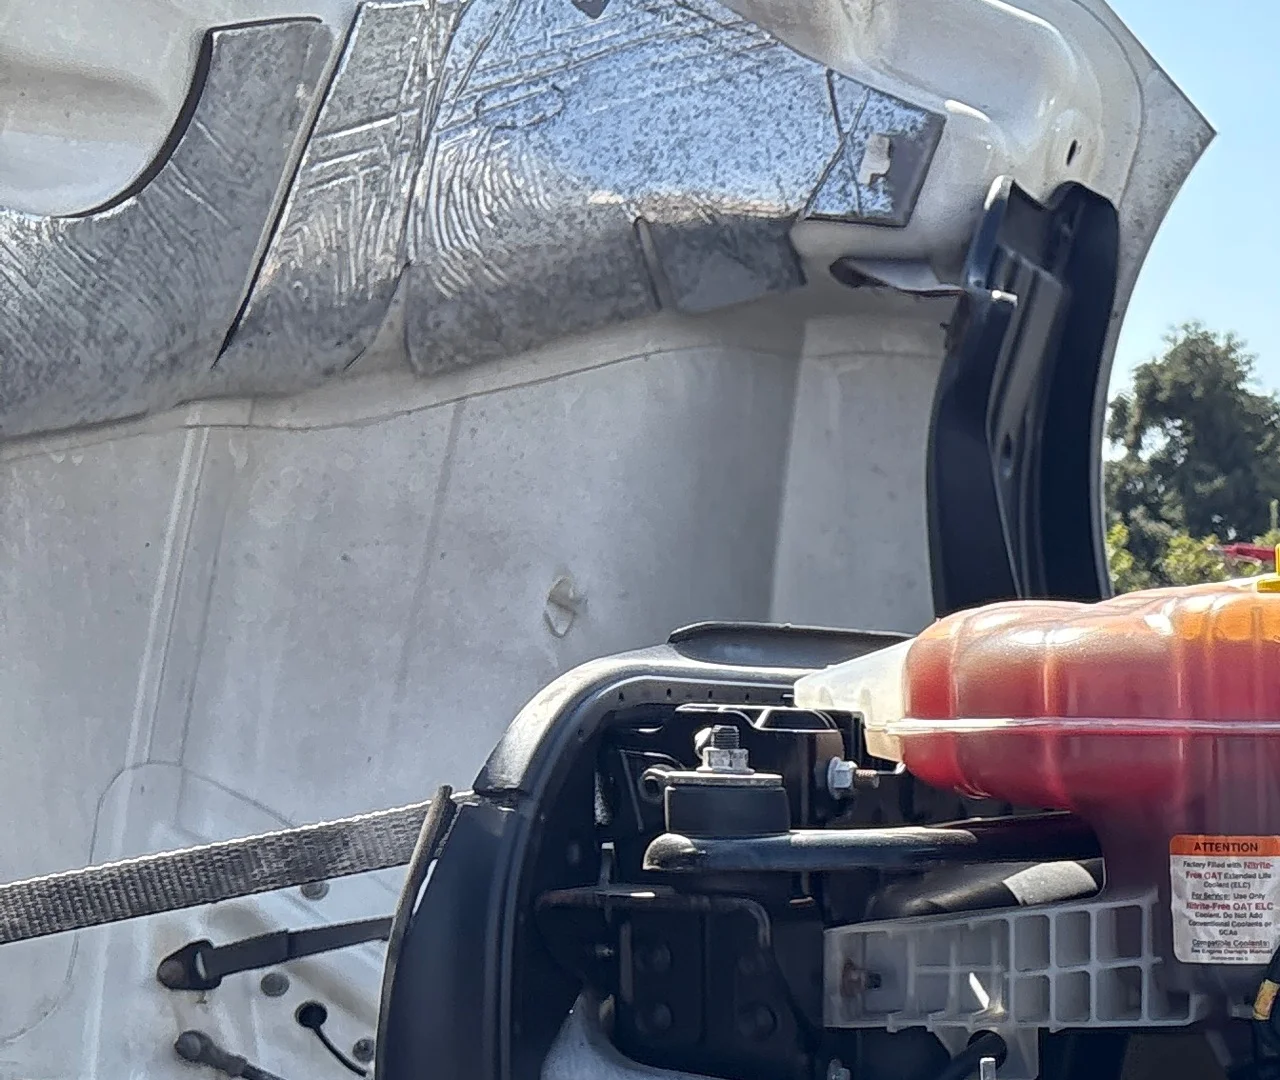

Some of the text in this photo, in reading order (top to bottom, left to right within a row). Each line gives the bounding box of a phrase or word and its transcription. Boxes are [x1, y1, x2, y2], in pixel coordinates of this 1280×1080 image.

[1194, 842, 1258, 852] ATTENTION
[1183, 861, 1206, 869] Factory
[1186, 871, 1202, 879] Free
[1204, 872, 1222, 880] OAT
